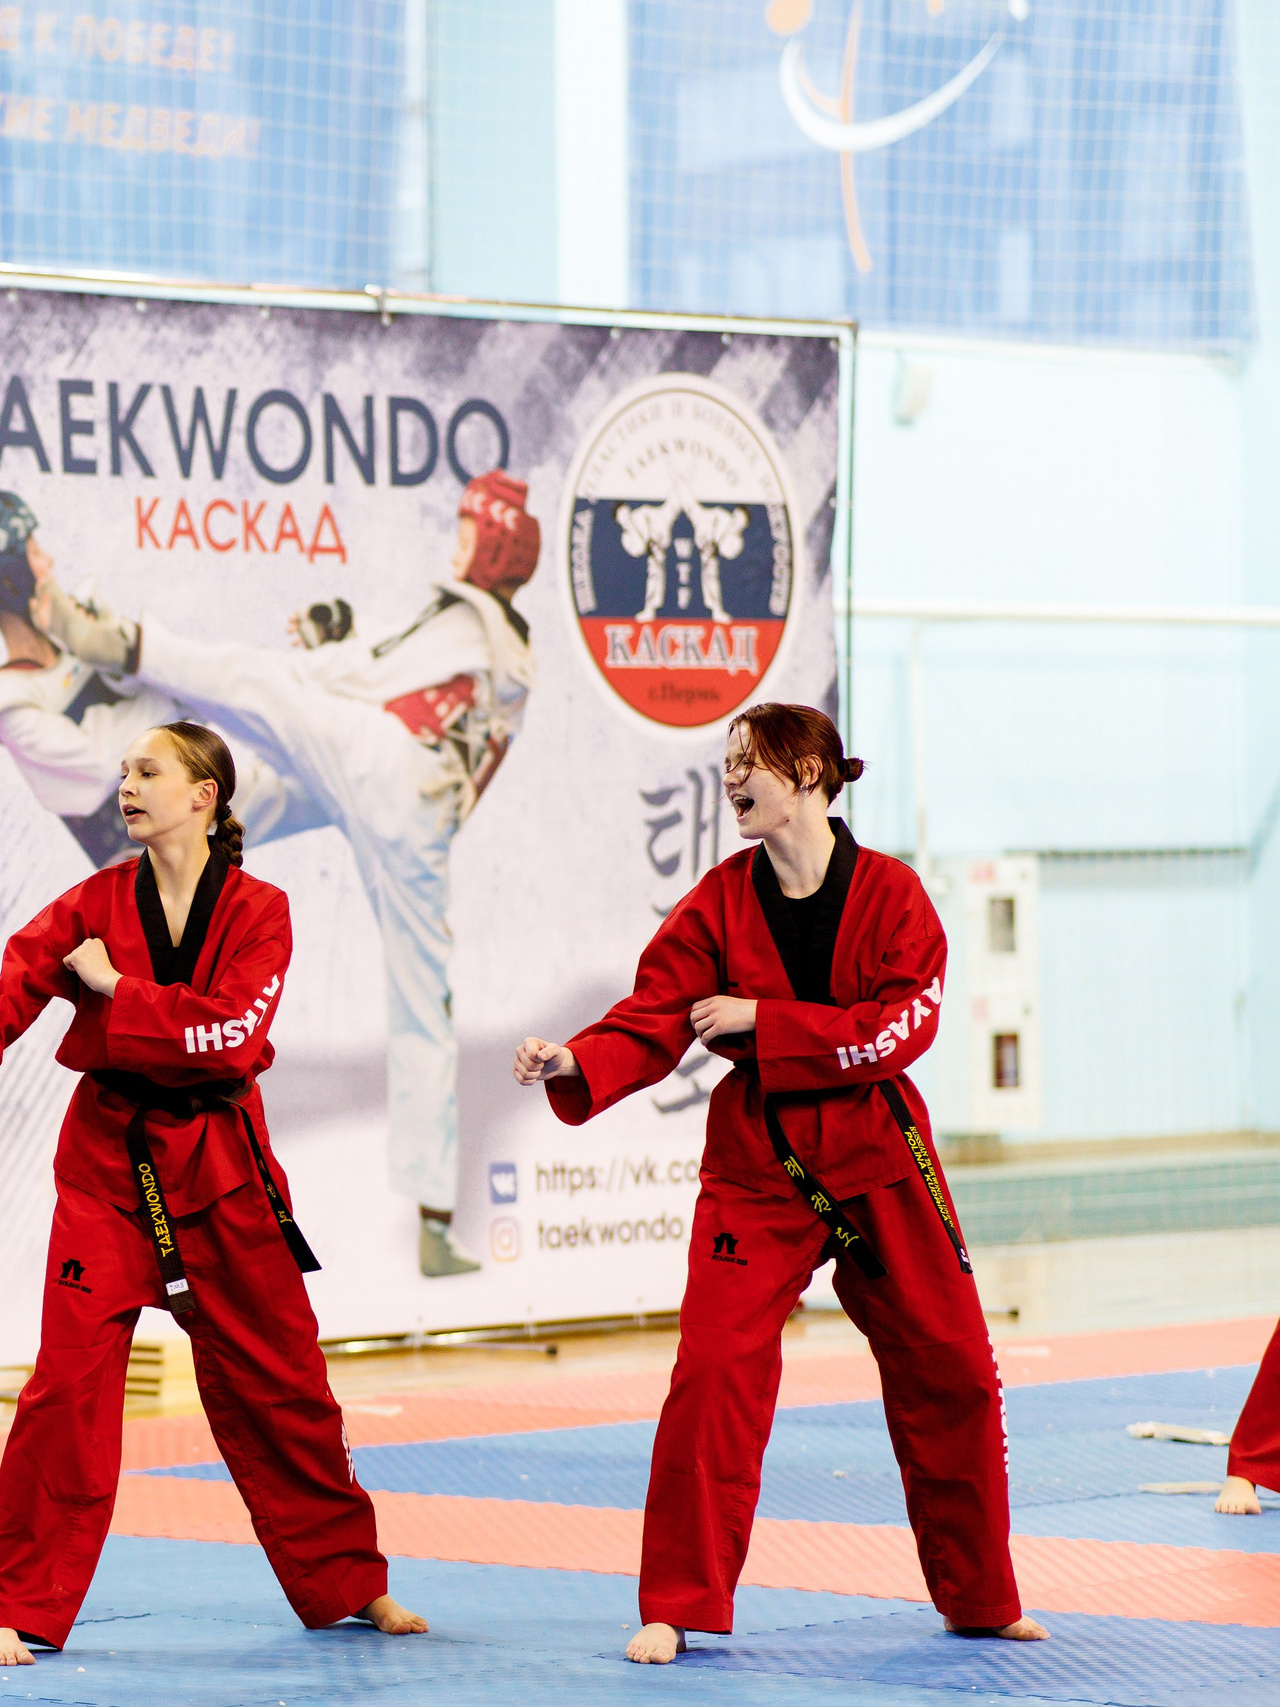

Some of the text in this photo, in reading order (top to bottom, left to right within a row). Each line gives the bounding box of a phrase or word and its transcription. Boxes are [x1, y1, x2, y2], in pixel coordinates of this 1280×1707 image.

[134, 495, 348, 564] КАСКАД
[604, 623, 759, 676] КАСКАД
[836, 976, 943, 1070] AYASHI
[139, 1163, 175, 1257] TAEKWONDO
[904, 1131, 948, 1222] POLINA KUDRINA
[537, 1209, 690, 1249] taekwondo
